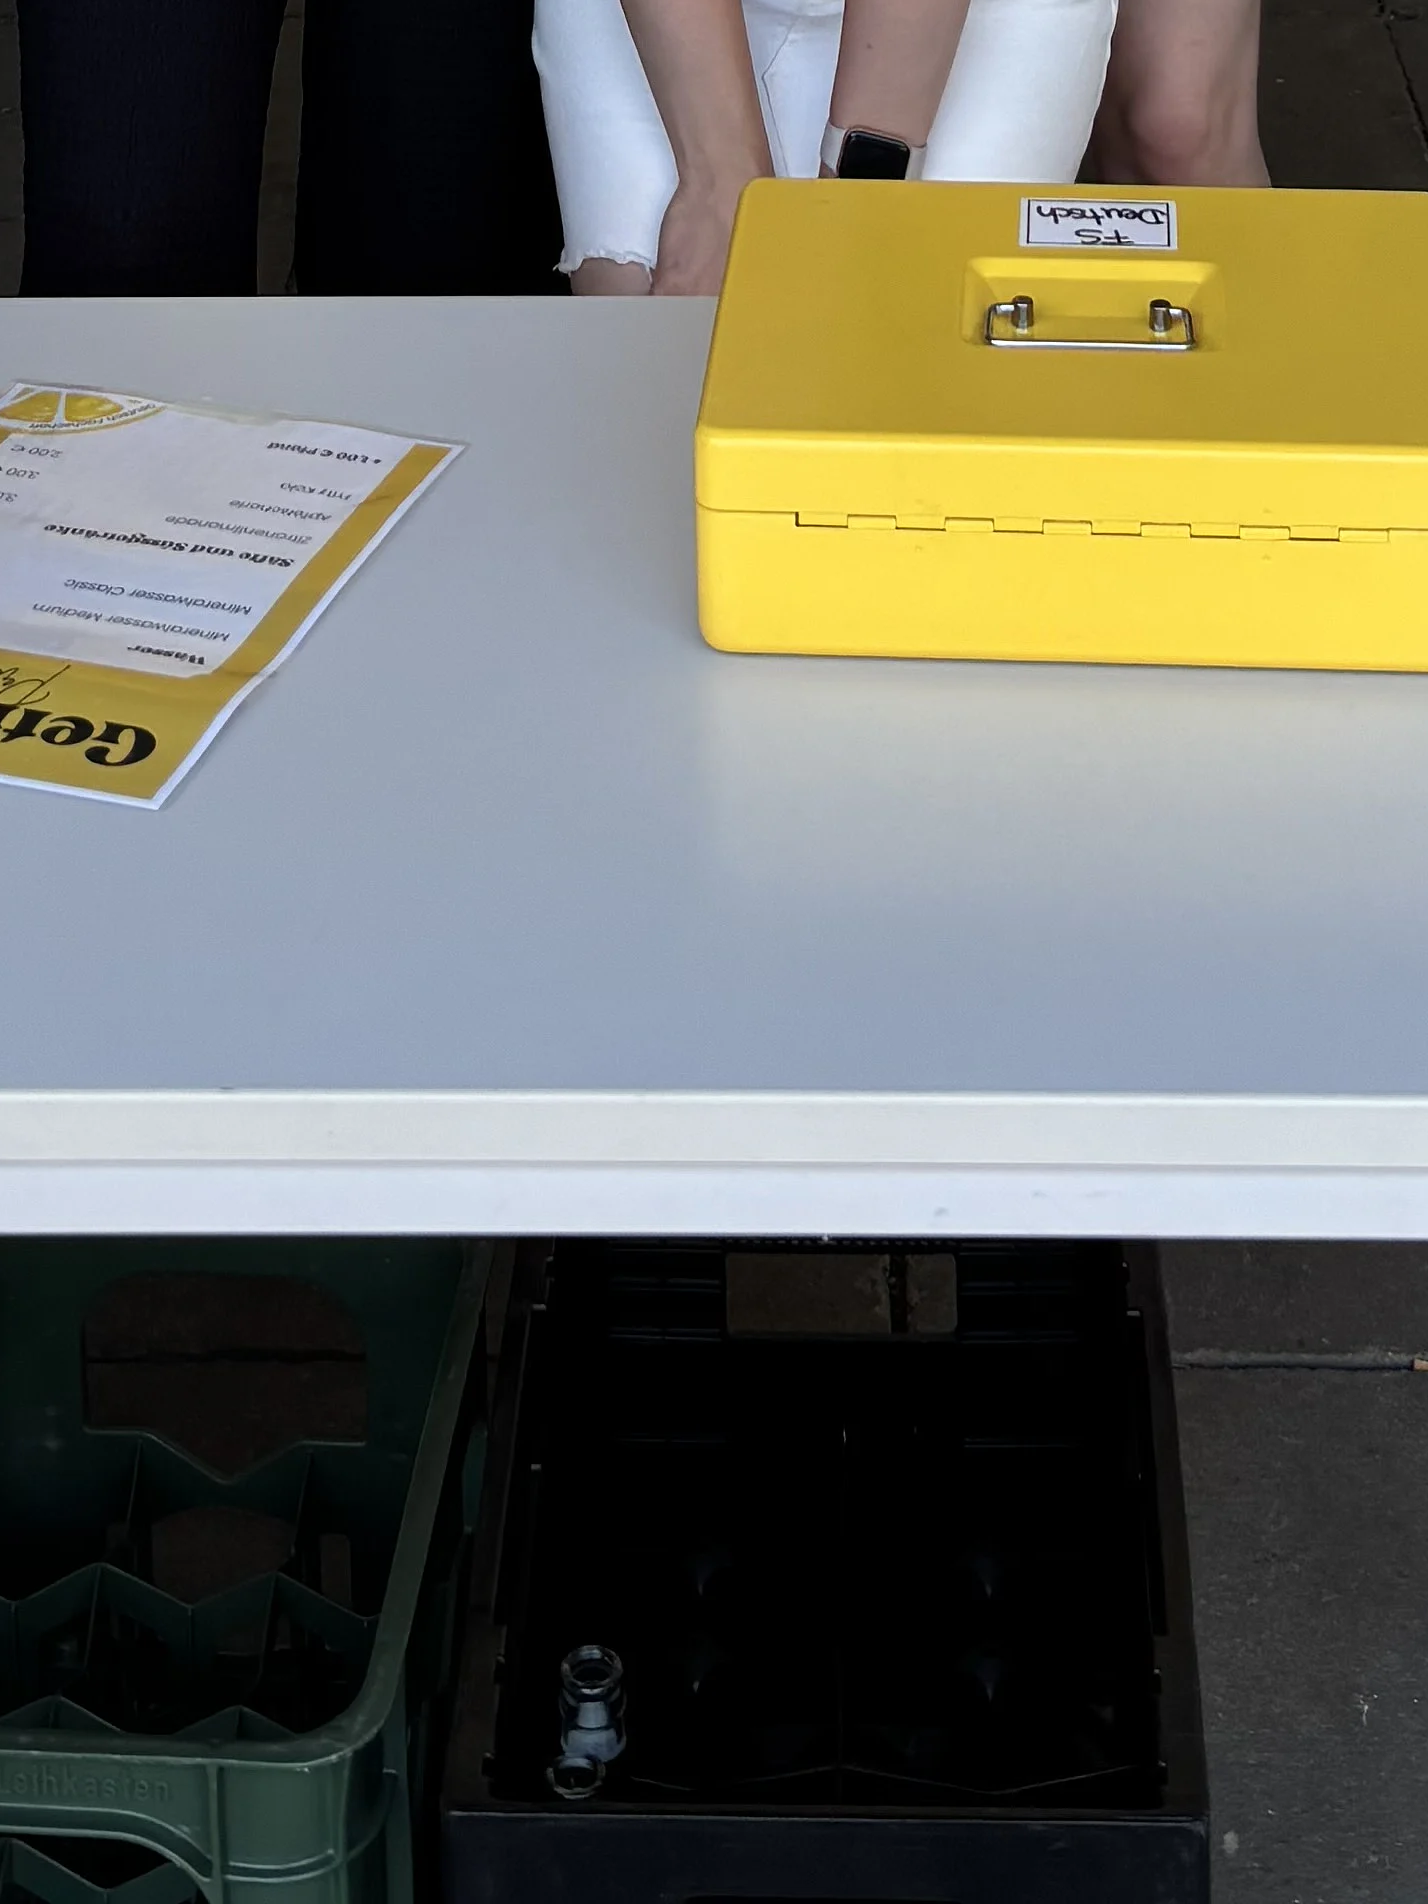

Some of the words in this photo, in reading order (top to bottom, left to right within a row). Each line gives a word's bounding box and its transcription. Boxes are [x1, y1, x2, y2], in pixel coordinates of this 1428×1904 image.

[1036, 205, 1168, 226] Deutsch
[189, 544, 234, 558] und
[64, 578, 125, 597] Classic
[33, 602, 103, 622] Medium
[130, 588, 252, 616] Mineralwasser
[107, 614, 230, 642] Mineralwasser
